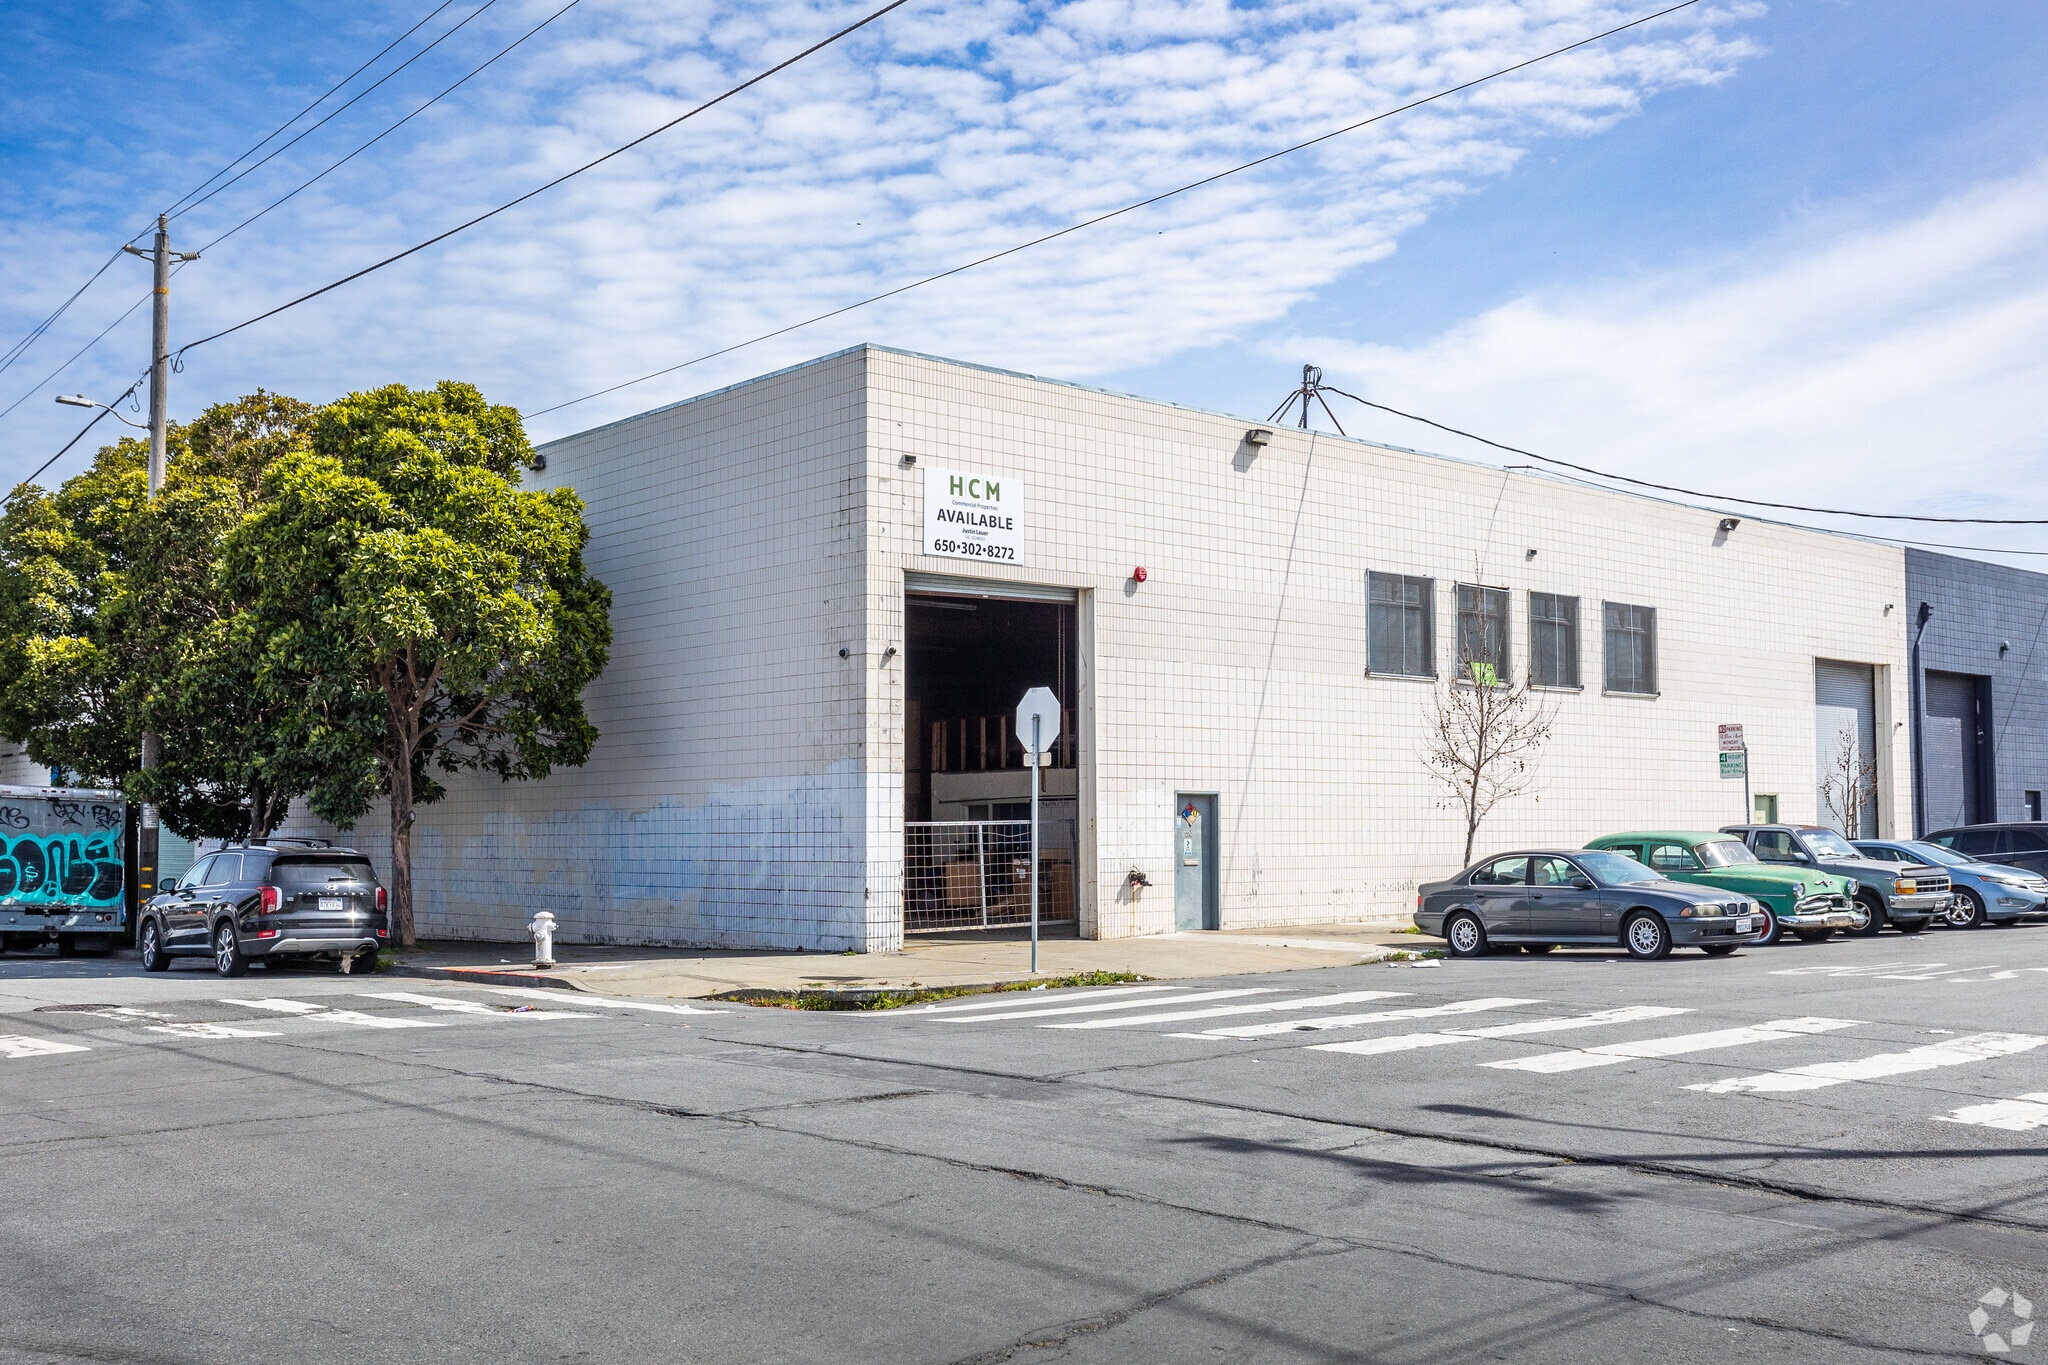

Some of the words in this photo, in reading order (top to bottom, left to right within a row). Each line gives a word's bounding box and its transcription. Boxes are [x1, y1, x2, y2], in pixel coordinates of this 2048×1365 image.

[949, 475, 1000, 502] HCM
[952, 499, 977, 508] Commercial
[977, 503, 999, 511] Properties
[937, 508, 1013, 530] AVAILABLE
[1720, 753, 1726, 762] 4
